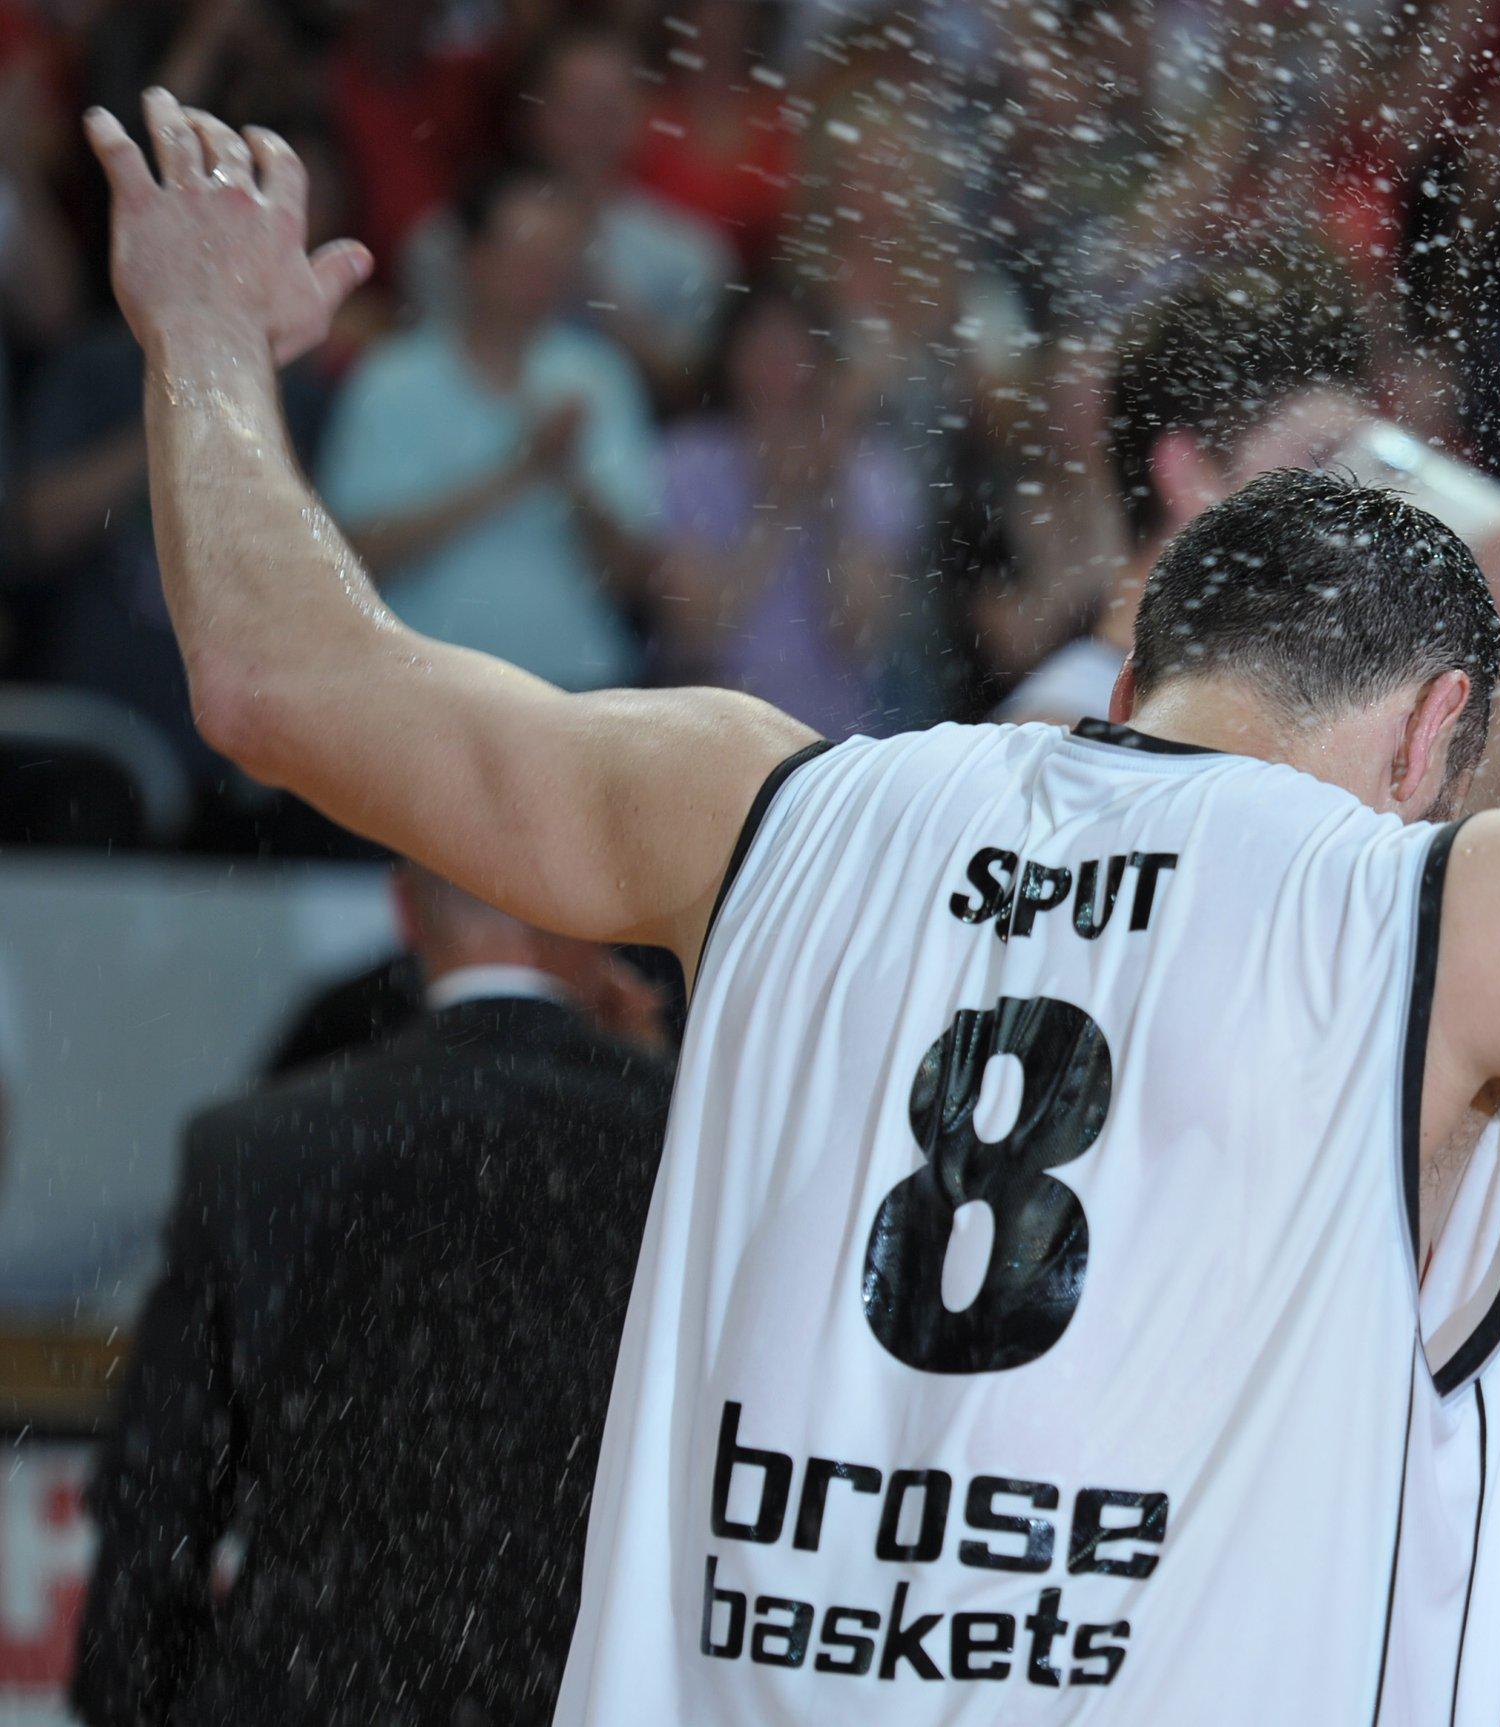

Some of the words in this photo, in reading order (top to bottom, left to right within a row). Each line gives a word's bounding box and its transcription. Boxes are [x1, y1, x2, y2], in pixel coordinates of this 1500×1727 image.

[861, 996, 1113, 1375] 8
[711, 1400, 1170, 1579] brose
[701, 1555, 1131, 1688] baskets
